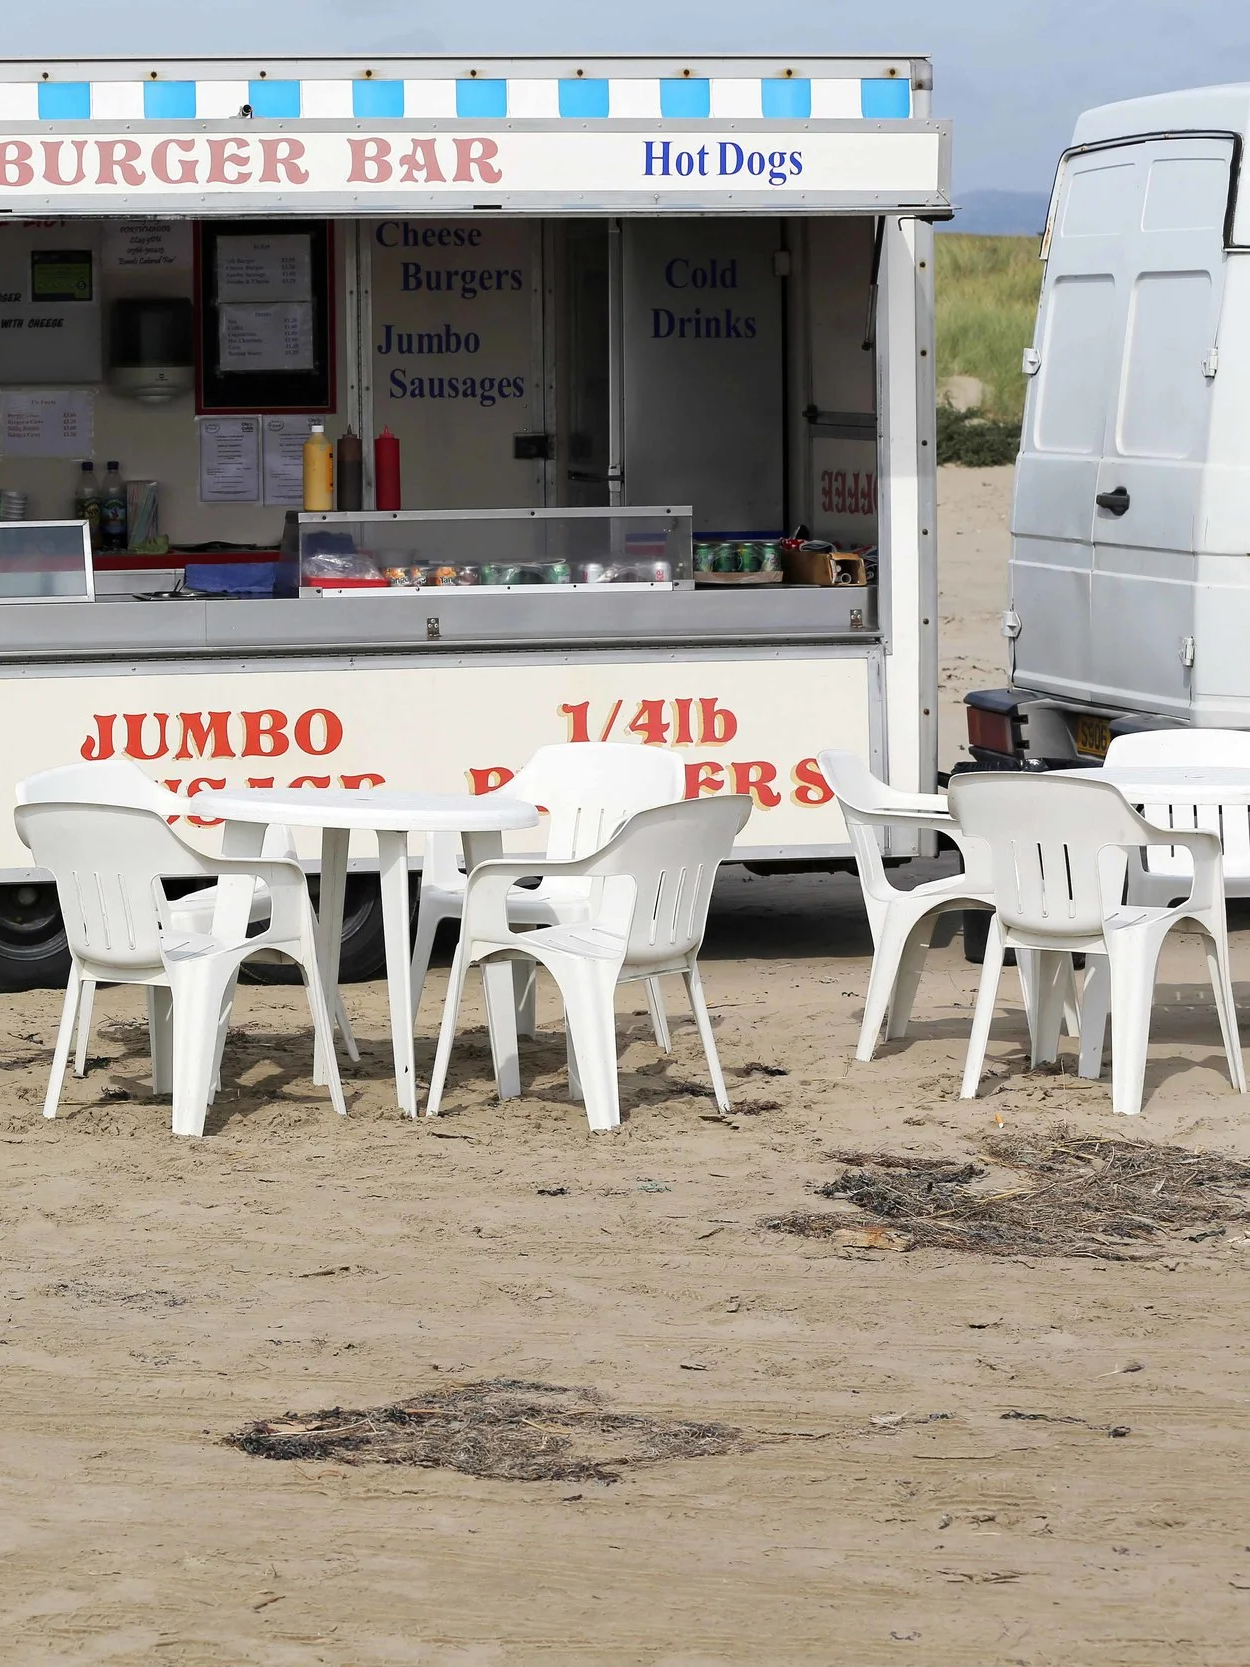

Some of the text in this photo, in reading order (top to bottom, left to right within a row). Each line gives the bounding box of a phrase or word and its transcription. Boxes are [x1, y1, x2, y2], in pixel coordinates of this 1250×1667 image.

[348, 137, 503, 183] BAR
[643, 141, 804, 186] Hot Dogs
[375, 220, 482, 247] Cheese
[400, 261, 523, 300] Burgers
[665, 258, 738, 289] Cold
[1, 318, 23, 329] WITH
[27, 318, 65, 329] CHEESE
[377, 323, 481, 355] Jumbo
[651, 307, 758, 339] Drinks
[389, 367, 525, 407] Sausages
[80, 707, 344, 762] JUMBO
